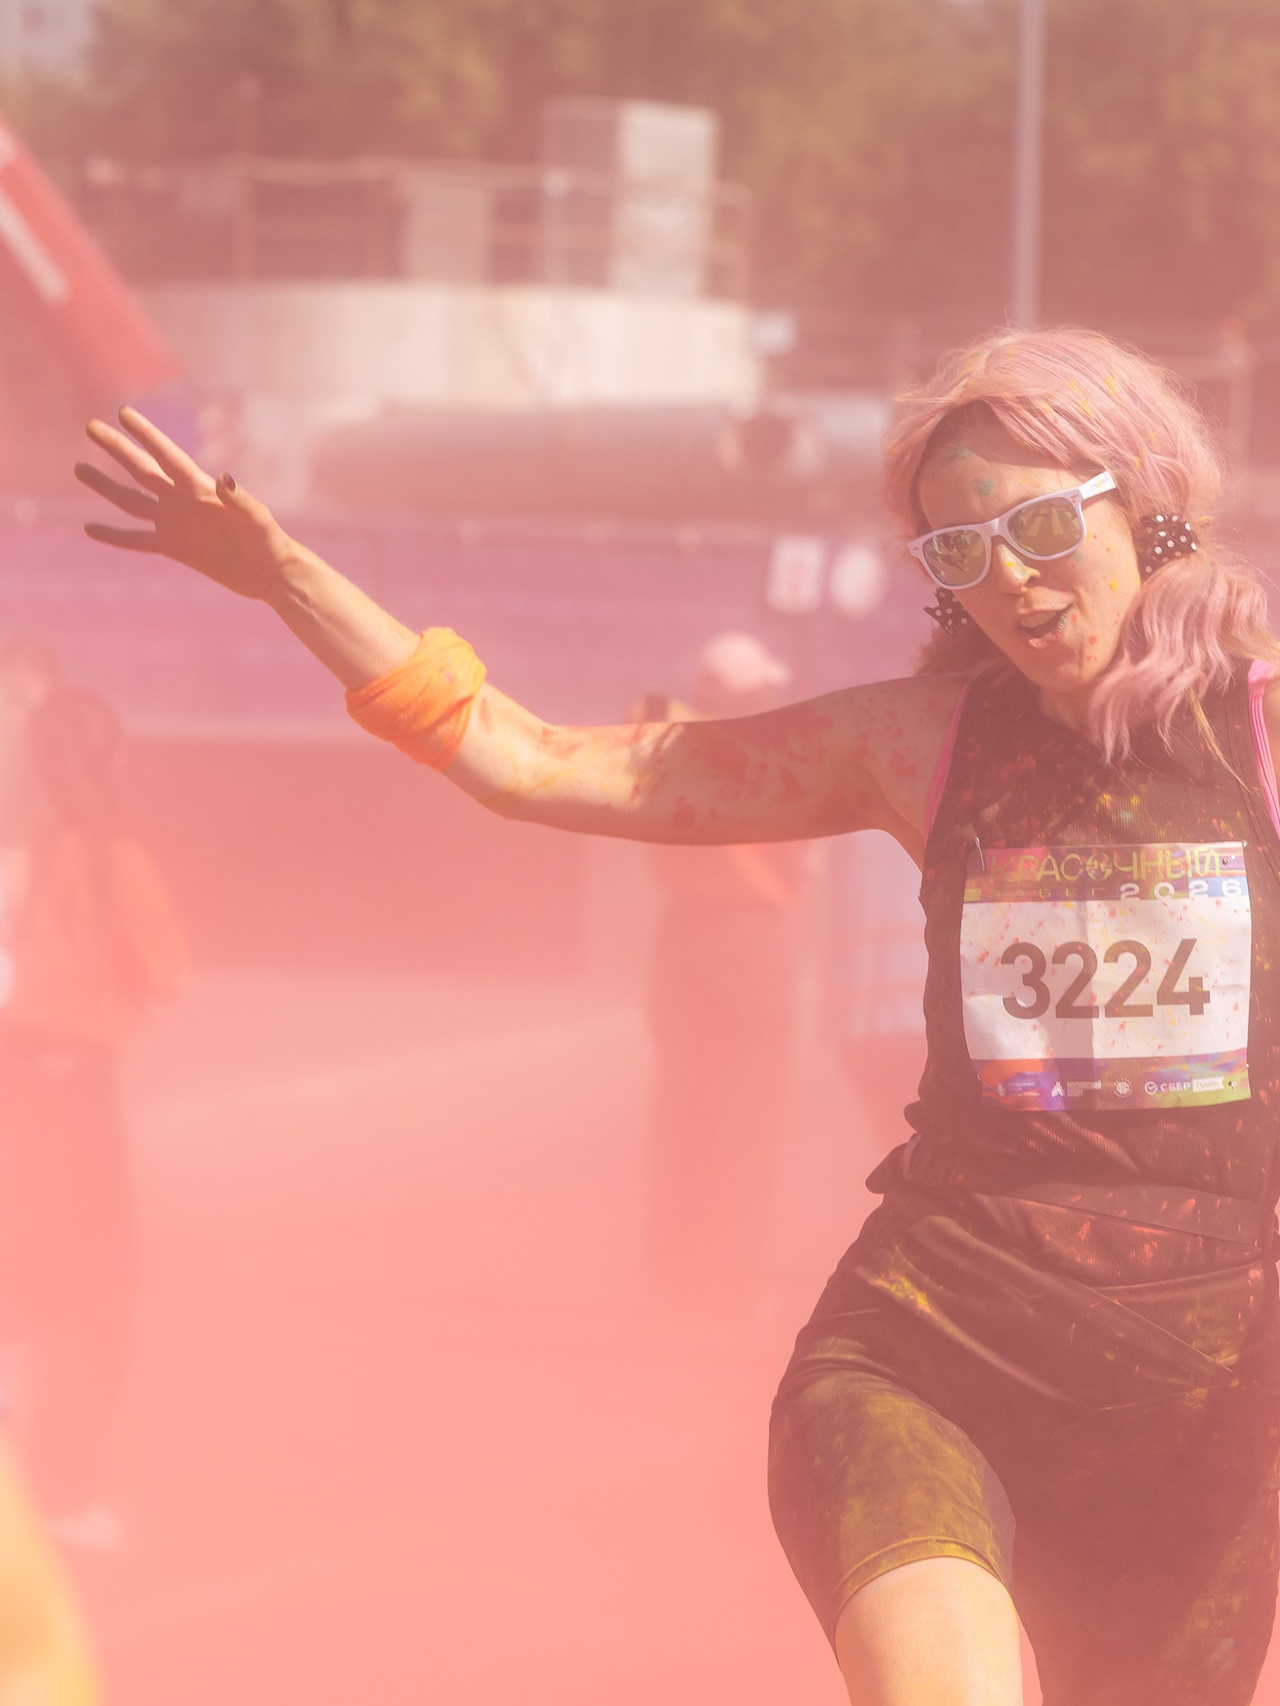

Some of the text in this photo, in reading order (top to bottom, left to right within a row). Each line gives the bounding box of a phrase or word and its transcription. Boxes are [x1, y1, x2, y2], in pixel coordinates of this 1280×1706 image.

[1120, 879, 1242, 900] 2026
[1000, 938, 1211, 1020] 3224
[1160, 1081, 1191, 1092] СБЕР
